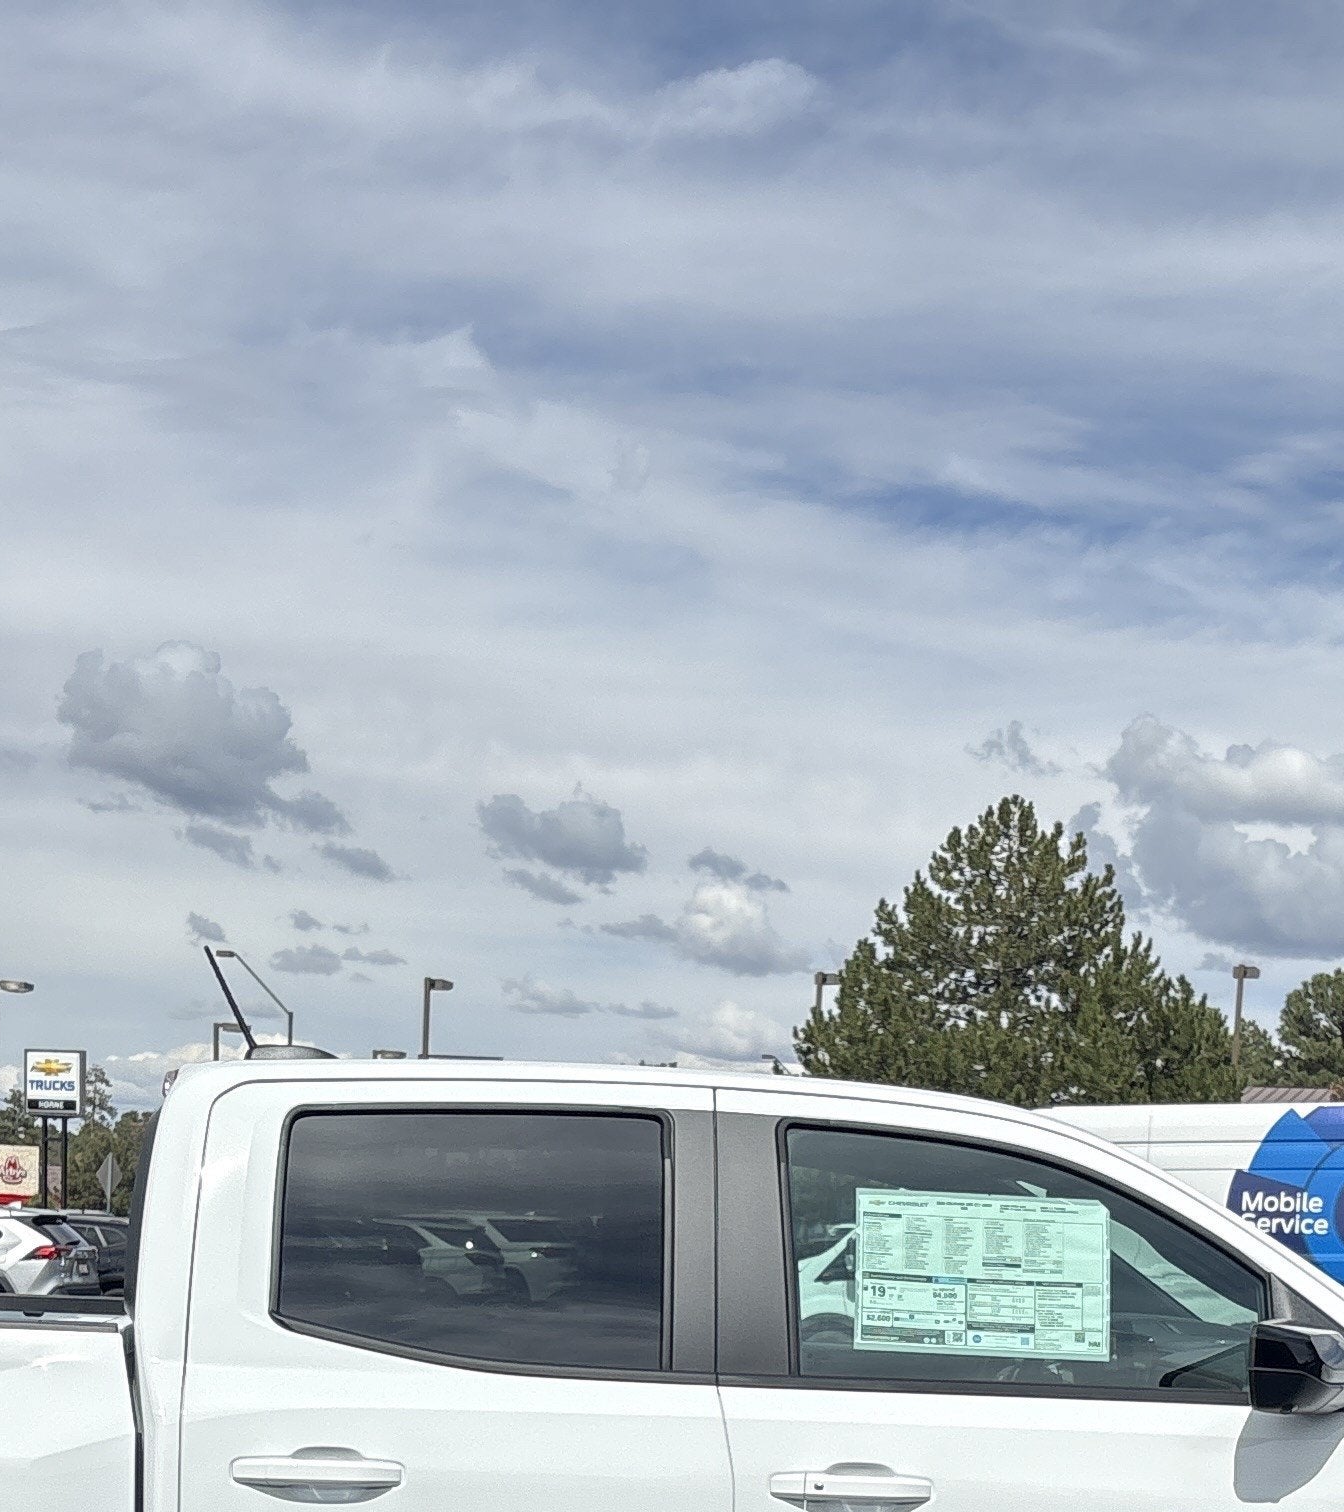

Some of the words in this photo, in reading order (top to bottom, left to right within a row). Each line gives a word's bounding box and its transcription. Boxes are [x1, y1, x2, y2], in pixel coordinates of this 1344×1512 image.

[28, 1080, 75, 1091] TRUCKS
[1241, 1191, 1323, 1213] Mobile
[870, 1285, 886, 1298] 19
